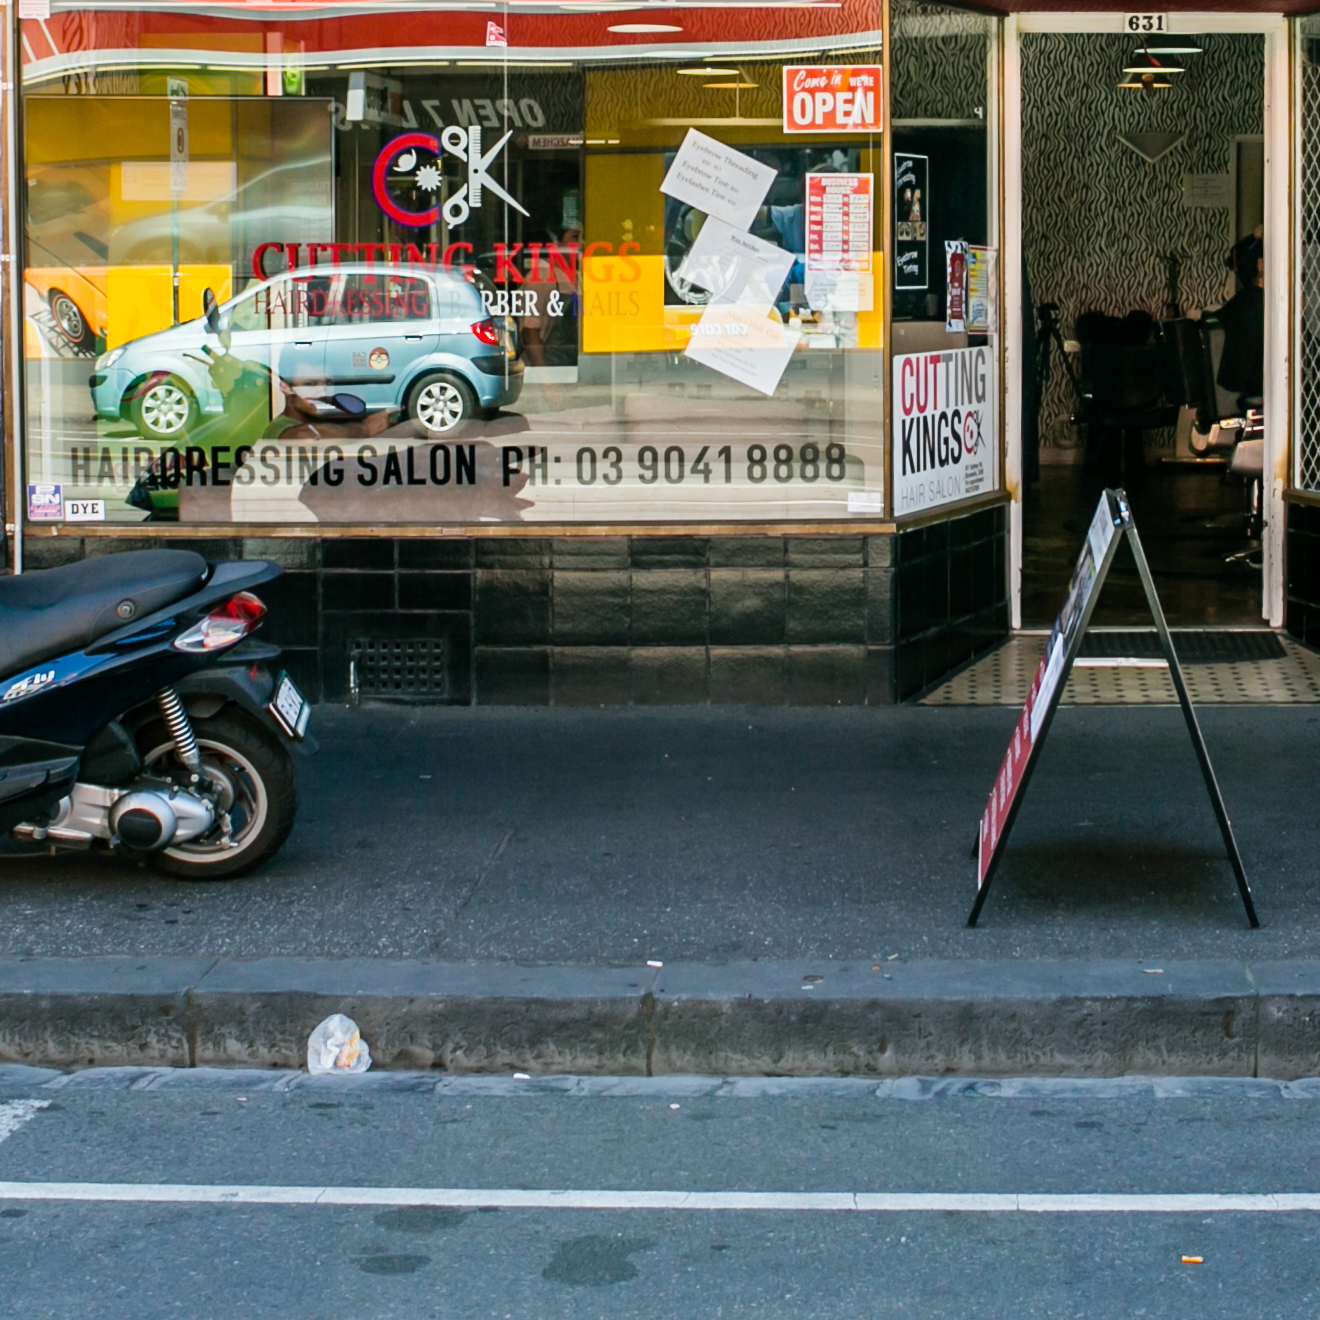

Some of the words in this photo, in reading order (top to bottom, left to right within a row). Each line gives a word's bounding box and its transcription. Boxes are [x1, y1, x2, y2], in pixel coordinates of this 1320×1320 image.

[1128, 15, 1164, 31] 631
[792, 91, 874, 126] OPEN
[723, 156, 759, 180] Threading
[252, 242, 475, 283] CUTTING
[493, 241, 642, 283] KINGS
[254, 289, 429, 316] HAIRDRESSING
[546, 291, 564, 317] &
[572, 289, 640, 317] NAILS
[901, 348, 986, 417] CUTTING
[902, 409, 962, 477] KINGS
[71, 445, 345, 487] HAIRDRESSING
[357, 444, 476, 487] SALON
[502, 446, 562, 486] PH:
[576, 446, 623, 485] 03
[637, 445, 731, 485] 9041
[746, 443, 846, 483] 8888
[71, 503, 99, 514] DYE
[901, 483, 926, 509] HAIR
[929, 476, 961, 502] SALON
